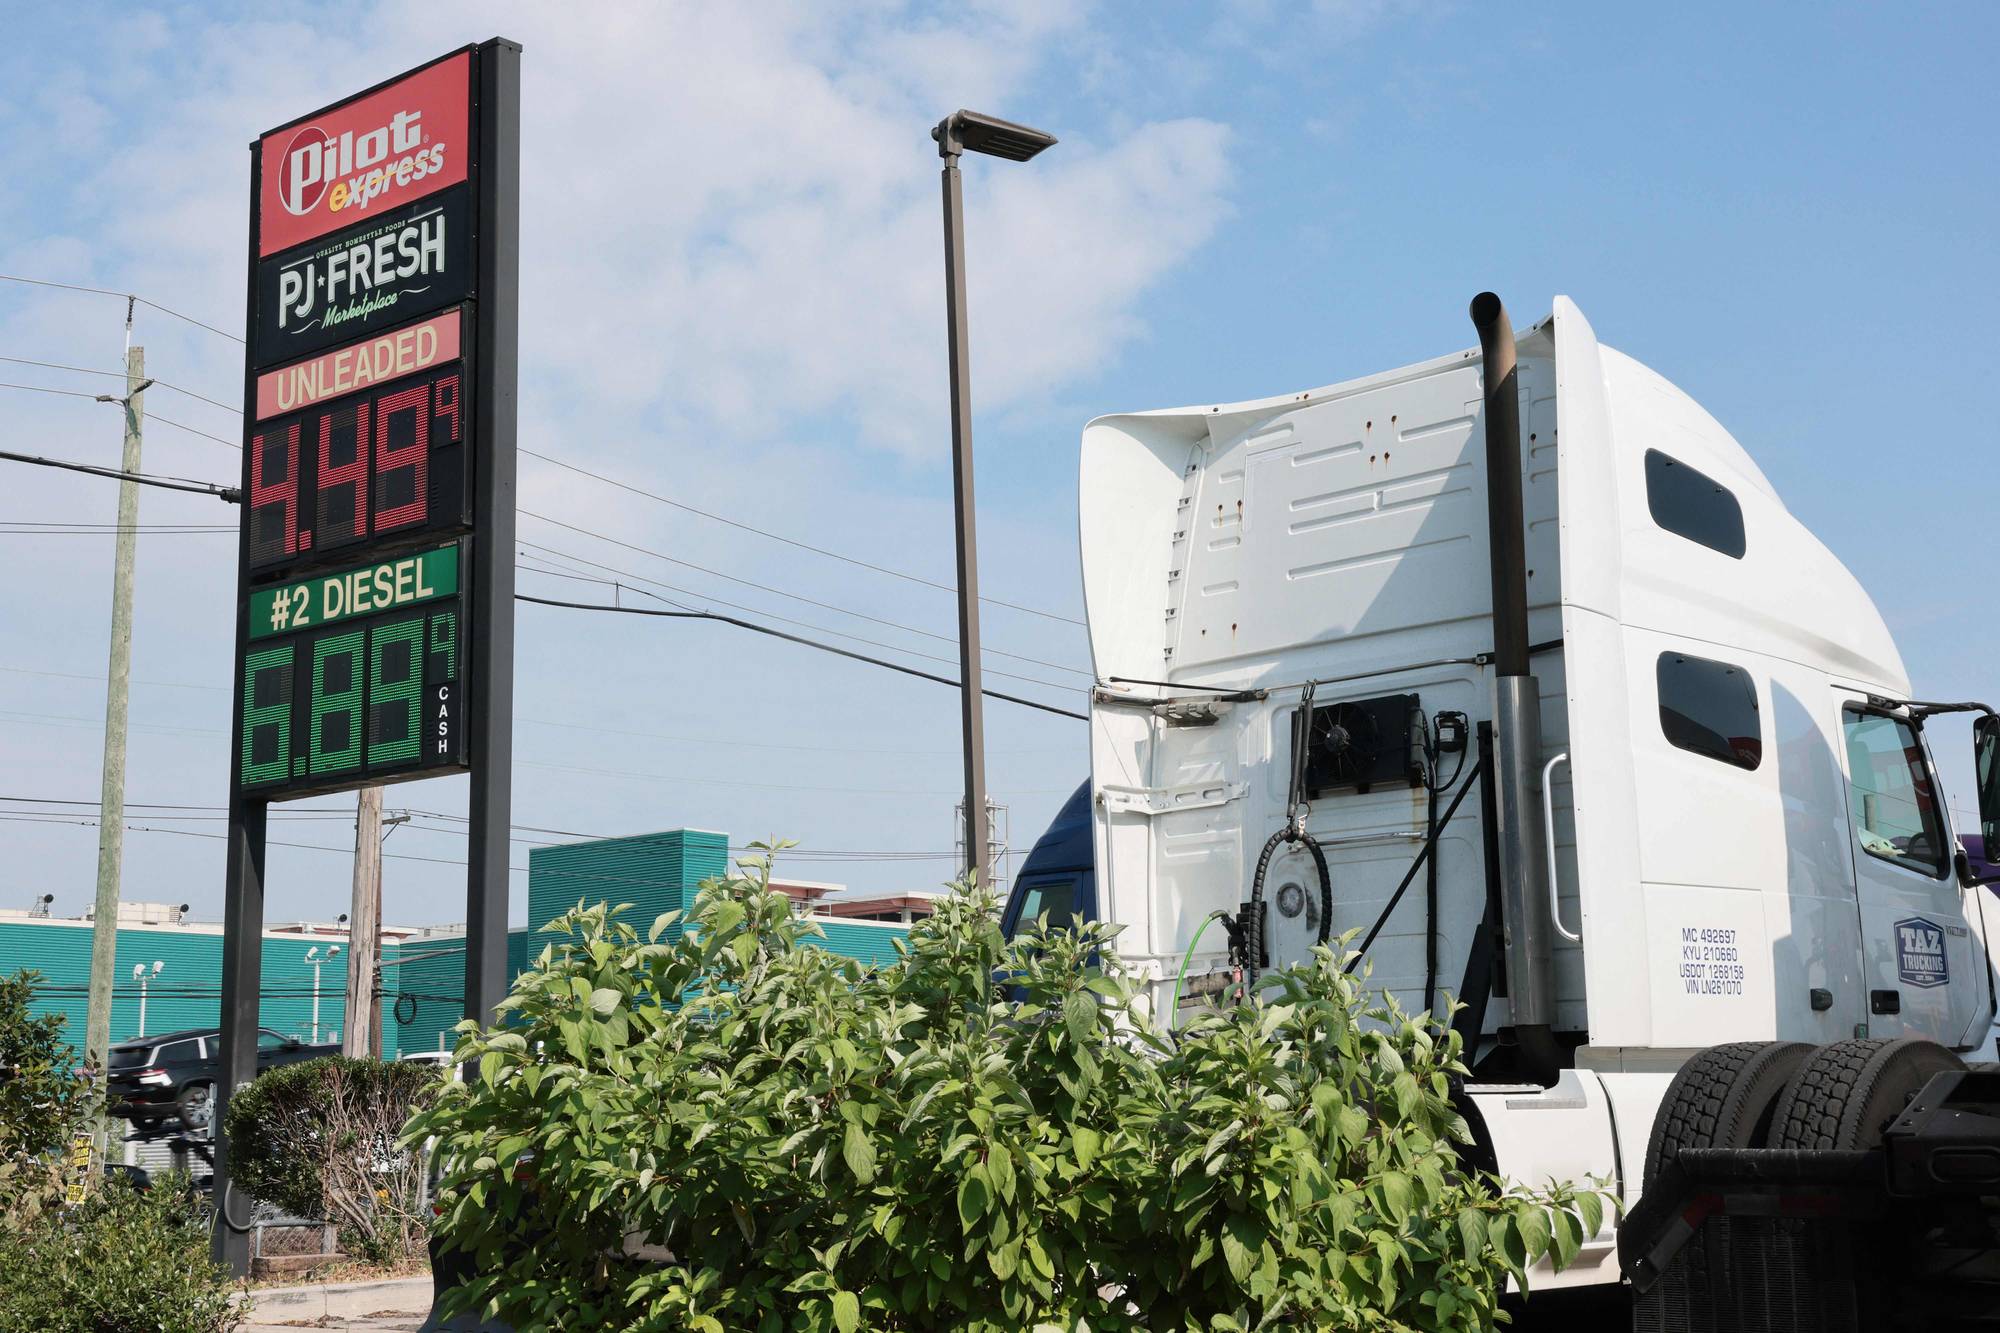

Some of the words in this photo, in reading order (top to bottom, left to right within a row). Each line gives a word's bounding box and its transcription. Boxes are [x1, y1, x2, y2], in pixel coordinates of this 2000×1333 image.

[290, 111, 422, 213] Pilot
[329, 143, 445, 213] express
[316, 243, 342, 259] QUALITY
[345, 227, 382, 248] HOMESTYLE
[385, 220, 406, 233] FOODS
[321, 289, 398, 329] Marketplace
[277, 325, 437, 410] UNLEADED
[270, 585, 310, 631] #2
[323, 557, 433, 621] DIESEL
[438, 686, 449, 754] CASH
[1682, 928, 1698, 942] MC
[1700, 929, 1736, 944] 492697
[1683, 946, 1701, 960] KYU
[1703, 946, 1738, 962] 210660
[1900, 927, 1942, 955] TAZ
[1680, 963, 1706, 978] USDOT
[1708, 964, 1744, 980] 1268158
[1902, 954, 1944, 971] TRUCKING
[1685, 979, 1700, 994] VIN
[1701, 979, 1742, 995] LN261070
